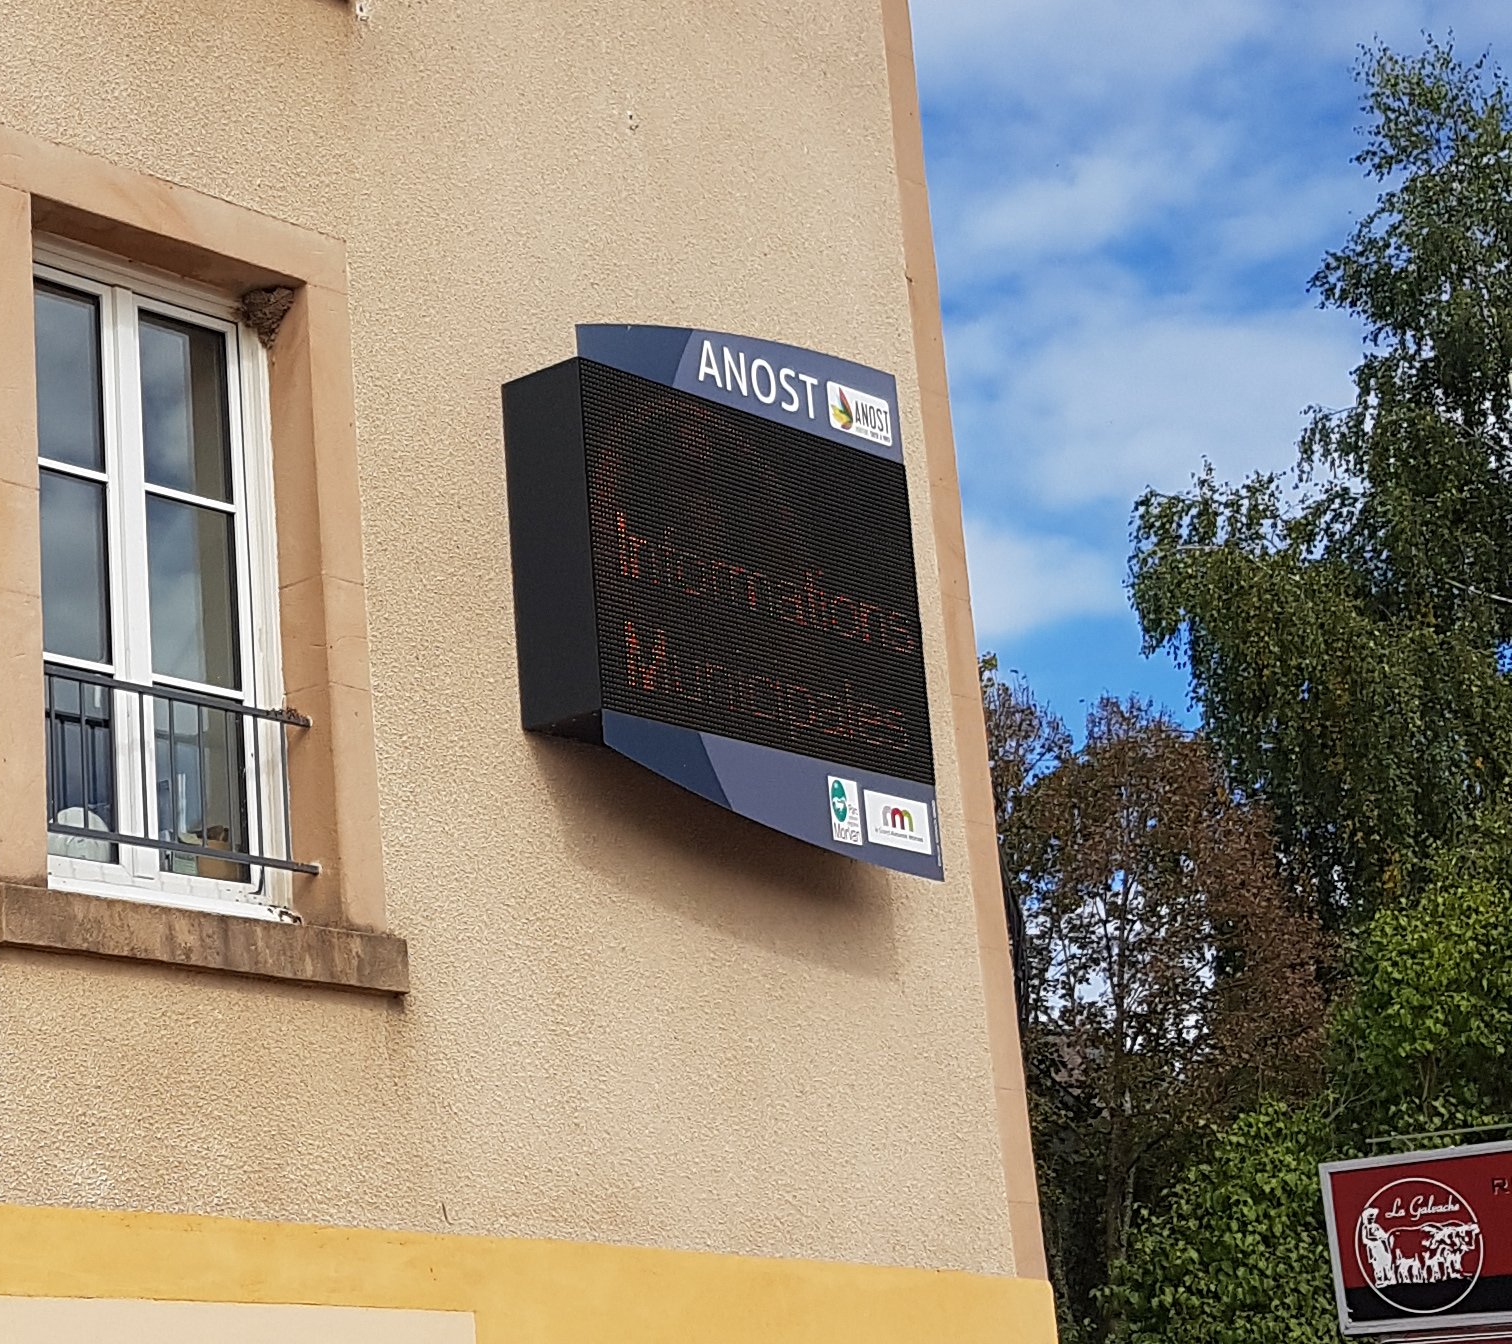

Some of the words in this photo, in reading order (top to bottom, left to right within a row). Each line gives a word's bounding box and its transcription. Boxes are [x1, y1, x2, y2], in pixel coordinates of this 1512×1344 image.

[698, 340, 818, 419] ANOST
[855, 400, 889, 434] ANOST
[1384, 1197, 1406, 1218] La
[1409, 1194, 1460, 1221] Galvache
